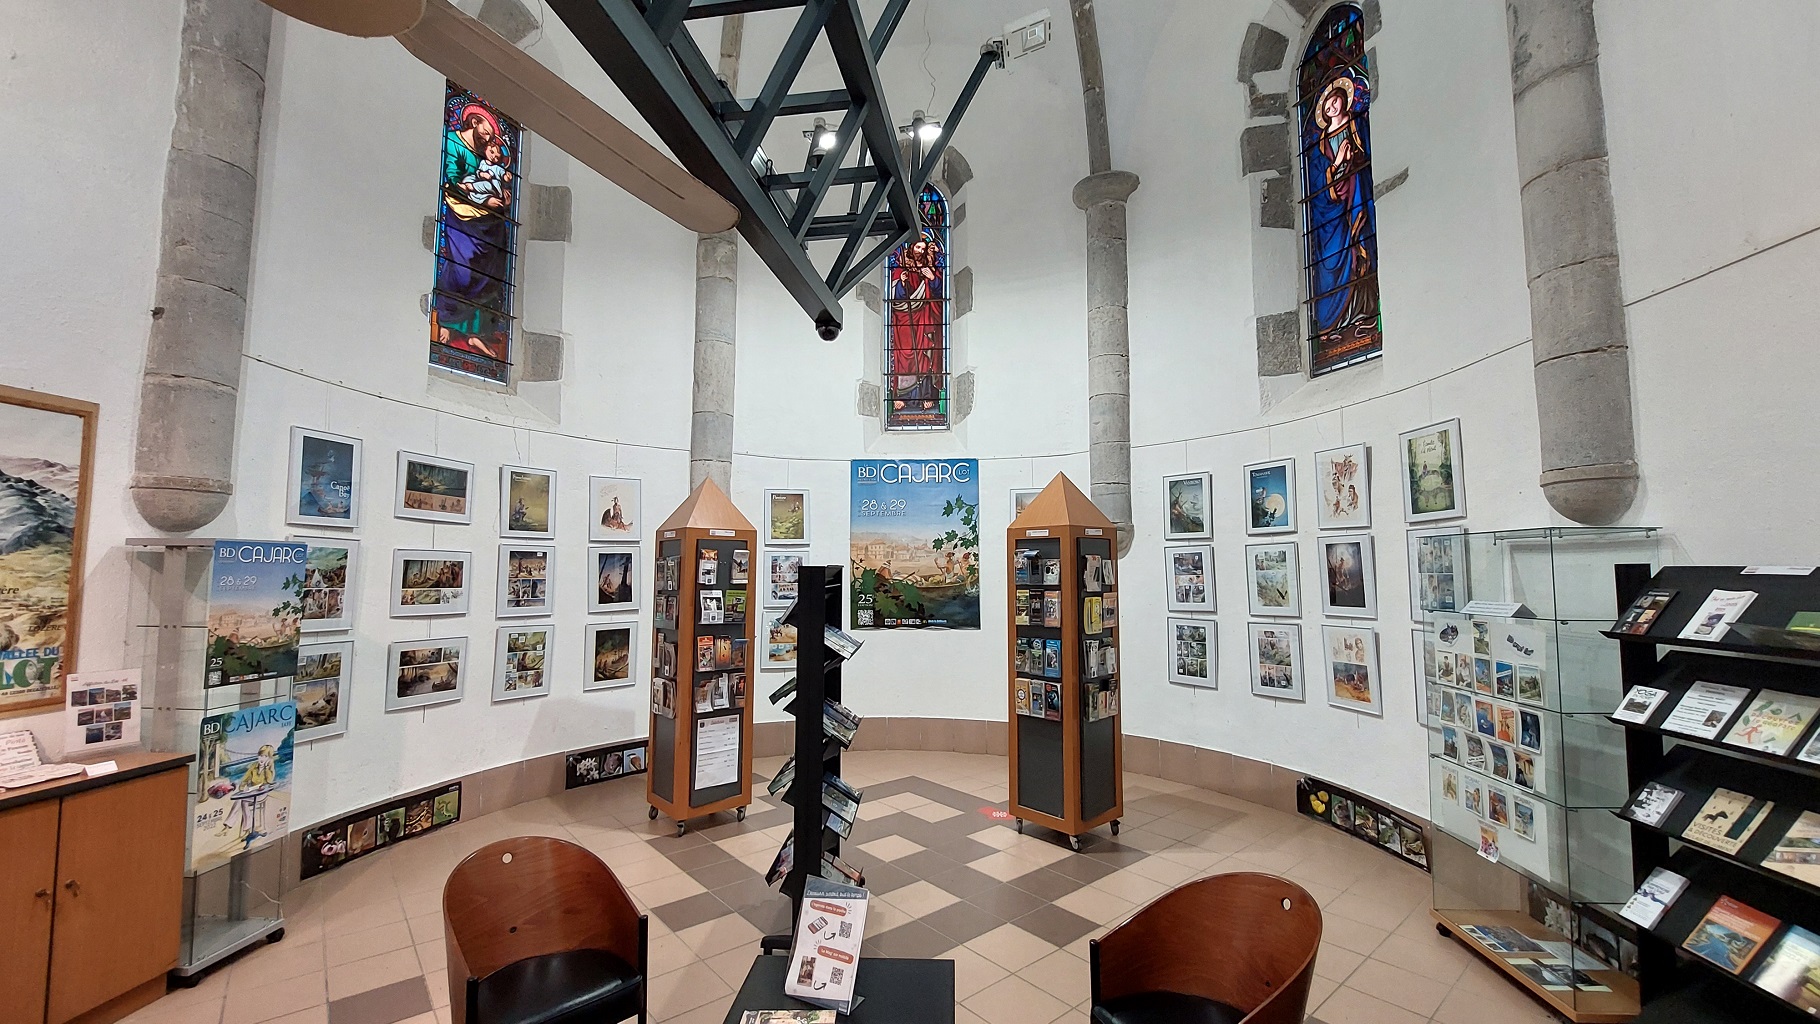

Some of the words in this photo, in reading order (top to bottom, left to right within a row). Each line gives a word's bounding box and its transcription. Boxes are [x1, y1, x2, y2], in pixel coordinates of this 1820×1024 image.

[857, 466, 877, 478] BD
[881, 463, 970, 483] CAJARC
[862, 499, 878, 510] 28
[881, 502, 887, 510] &
[889, 499, 907, 510] 29
[220, 548, 236, 558] BD
[238, 546, 304, 563] CAJARC
[220, 576, 235, 586] 28
[243, 576, 257, 585] 29
[858, 594, 873, 604] 25
[44, 646, 59, 657] DU
[210, 657, 223, 667] 25
[203, 722, 220, 735] BD
[224, 705, 293, 733] CAJARC
[196, 813, 208, 823] 24
[213, 808, 224, 817] 25
[1693, 821, 1722, 836] VISITES
